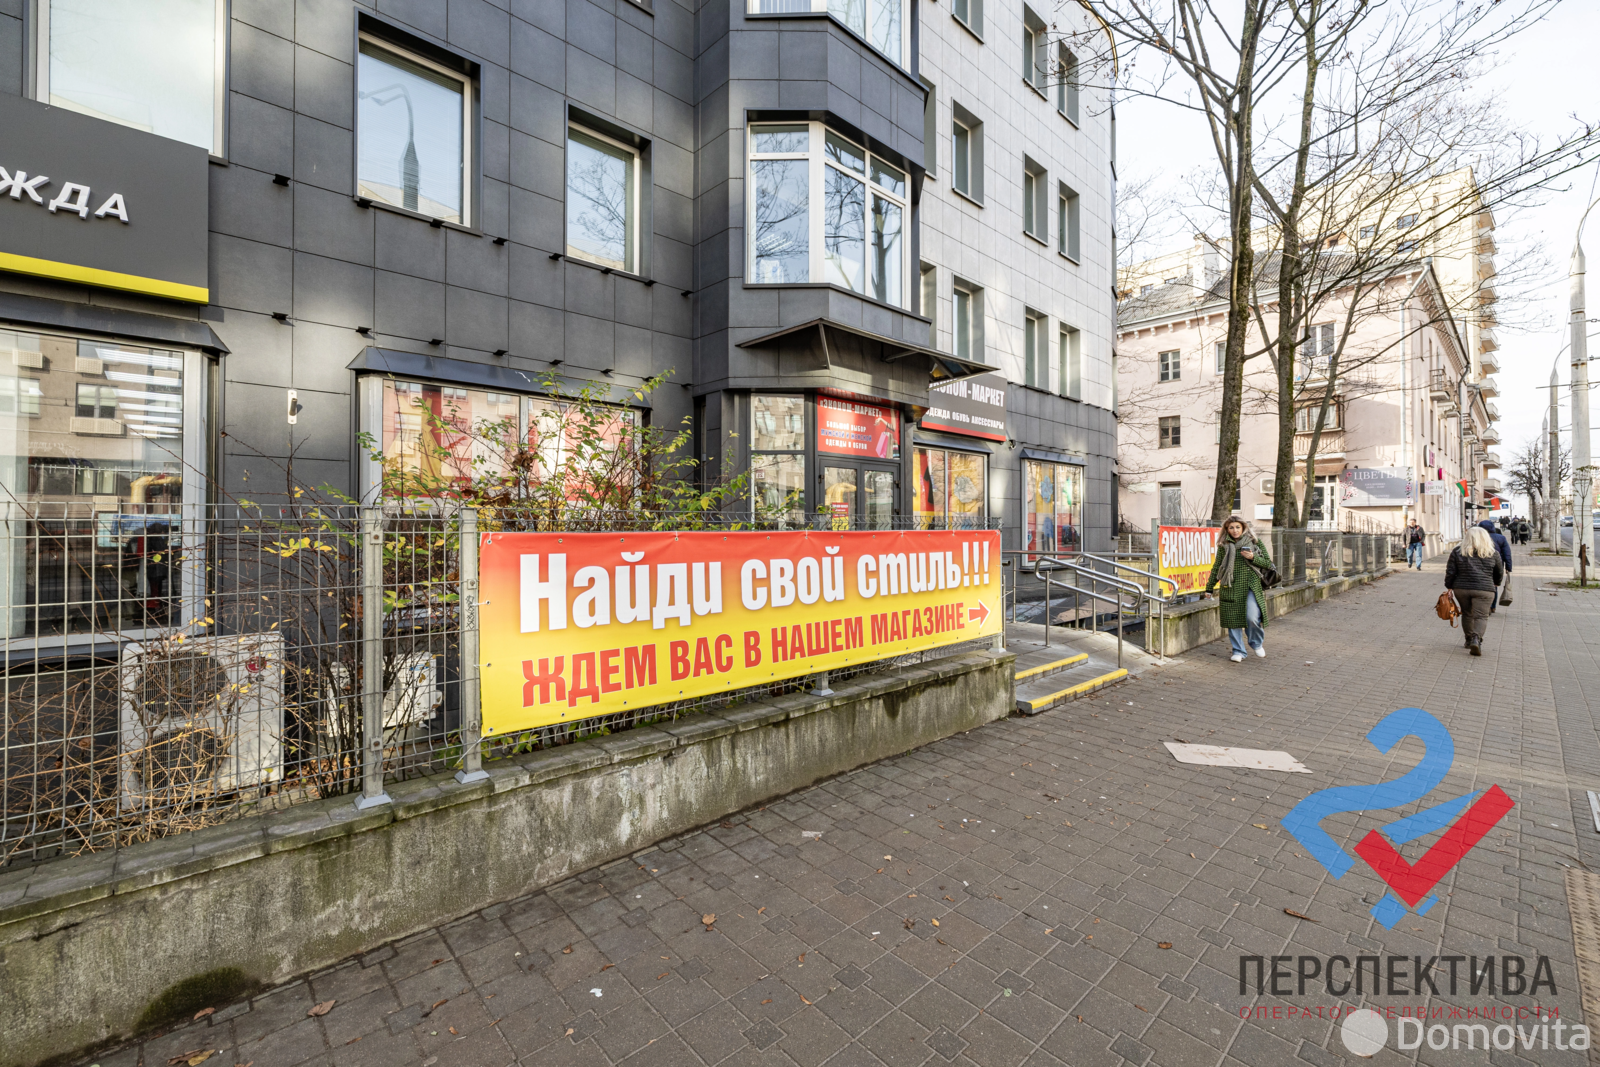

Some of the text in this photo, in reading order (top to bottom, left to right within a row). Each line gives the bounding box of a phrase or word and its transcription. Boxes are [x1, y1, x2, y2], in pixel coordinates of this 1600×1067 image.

[826, 420, 867, 433] БОЛЬШОЙ ВЫБОР
[952, 411, 970, 423] ОБУВЬ
[971, 415, 1004, 430] АКСЕССУАРЫ
[821, 428, 845, 438] МУЖСКОЙ
[851, 434, 872, 442] ЖЕНСКОЙ
[825, 438, 847, 448] ОДЕЖДЫ
[853, 442, 868, 450] ОБУВИ
[1354, 470, 1398, 481] ЦВЕТЫ
[520, 551, 722, 634] Найди
[741, 545, 845, 610] свой
[857, 541, 990, 599] стиль!!!
[521, 602, 965, 708] ЖДЕМ ВАС В НАШЕМ МАГАЗИНЕ
